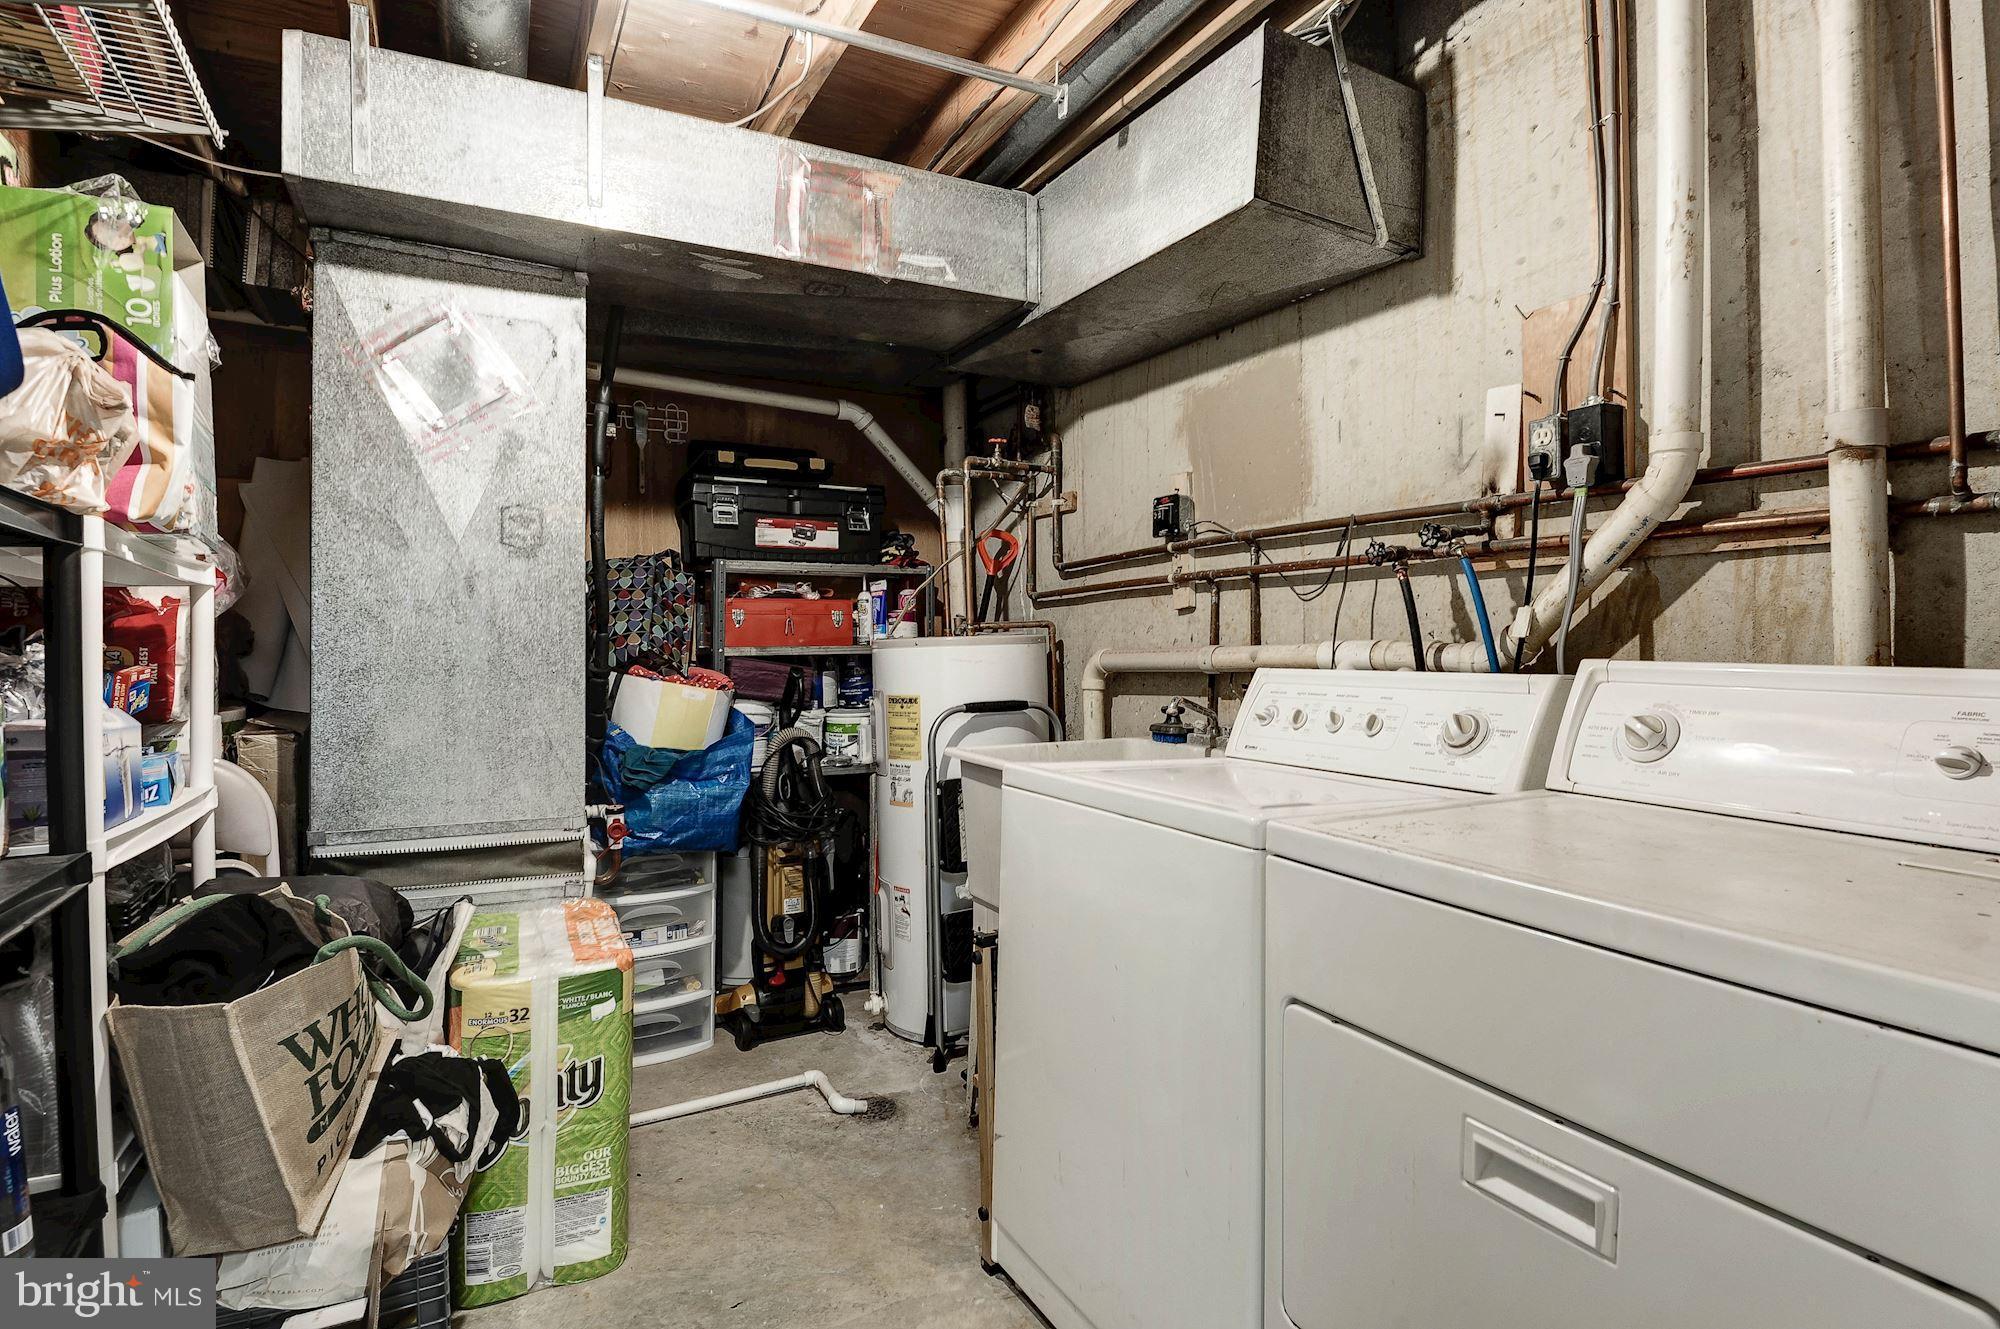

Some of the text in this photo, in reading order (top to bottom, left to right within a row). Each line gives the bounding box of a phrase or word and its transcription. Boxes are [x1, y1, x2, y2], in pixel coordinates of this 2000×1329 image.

[49, 232, 63, 304] Plus Lotion
[126, 297, 153, 327] 10
[138, 647, 149, 666] GEST
[467, 1007, 530, 1027] ENORMOUS 32
[3, 1111, 22, 1157] water
[583, 1146, 612, 1162] OUR
[555, 1156, 612, 1178] BIGGEST
[555, 1166, 612, 1185] BOUNTY PACK
[257, 1247, 283, 1257] really
[286, 1242, 305, 1251] cold
